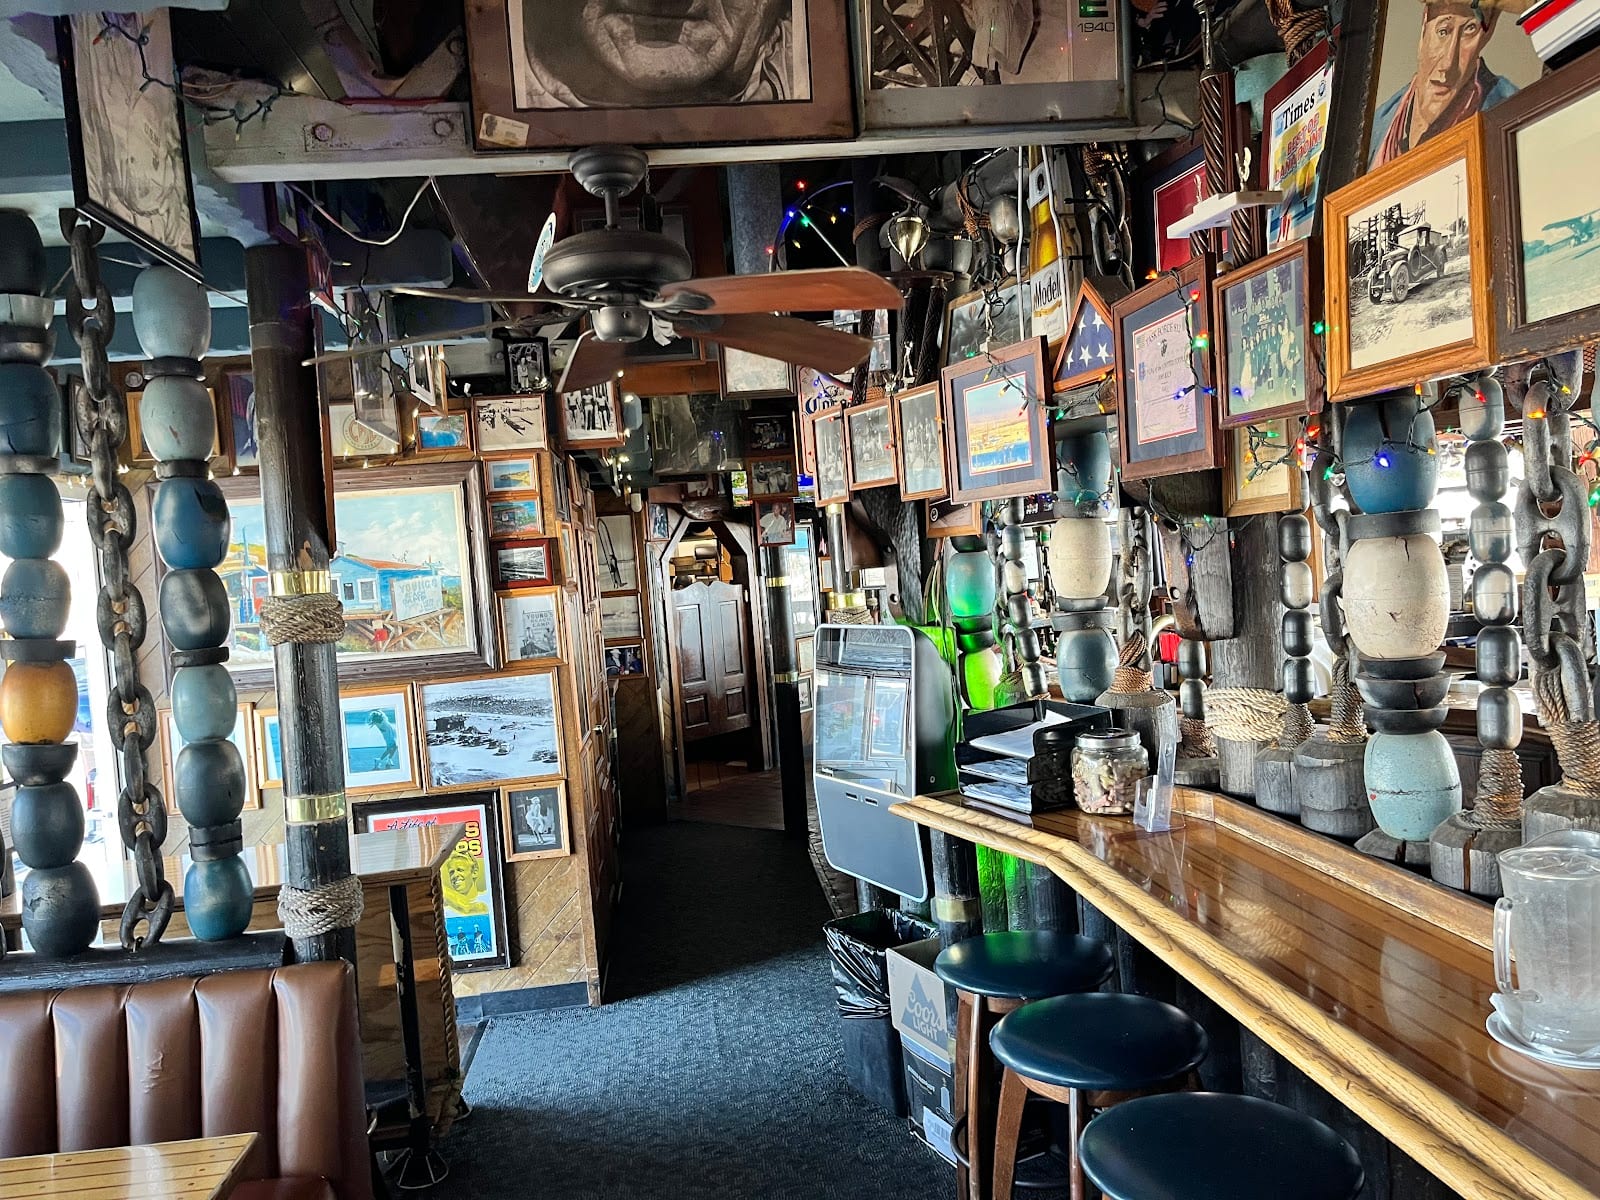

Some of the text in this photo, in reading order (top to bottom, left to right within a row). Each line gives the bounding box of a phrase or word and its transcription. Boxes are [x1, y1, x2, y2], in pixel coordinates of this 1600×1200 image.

[1077, 22, 1115, 32] 1940
[1282, 91, 1316, 130] Times
[1287, 112, 1320, 156] BEST OF
[1274, 126, 1323, 183] DANA POINT
[1034, 272, 1062, 310] Model
[906, 990, 945, 1031] Coors
[912, 1015, 938, 1042] LIGHT
